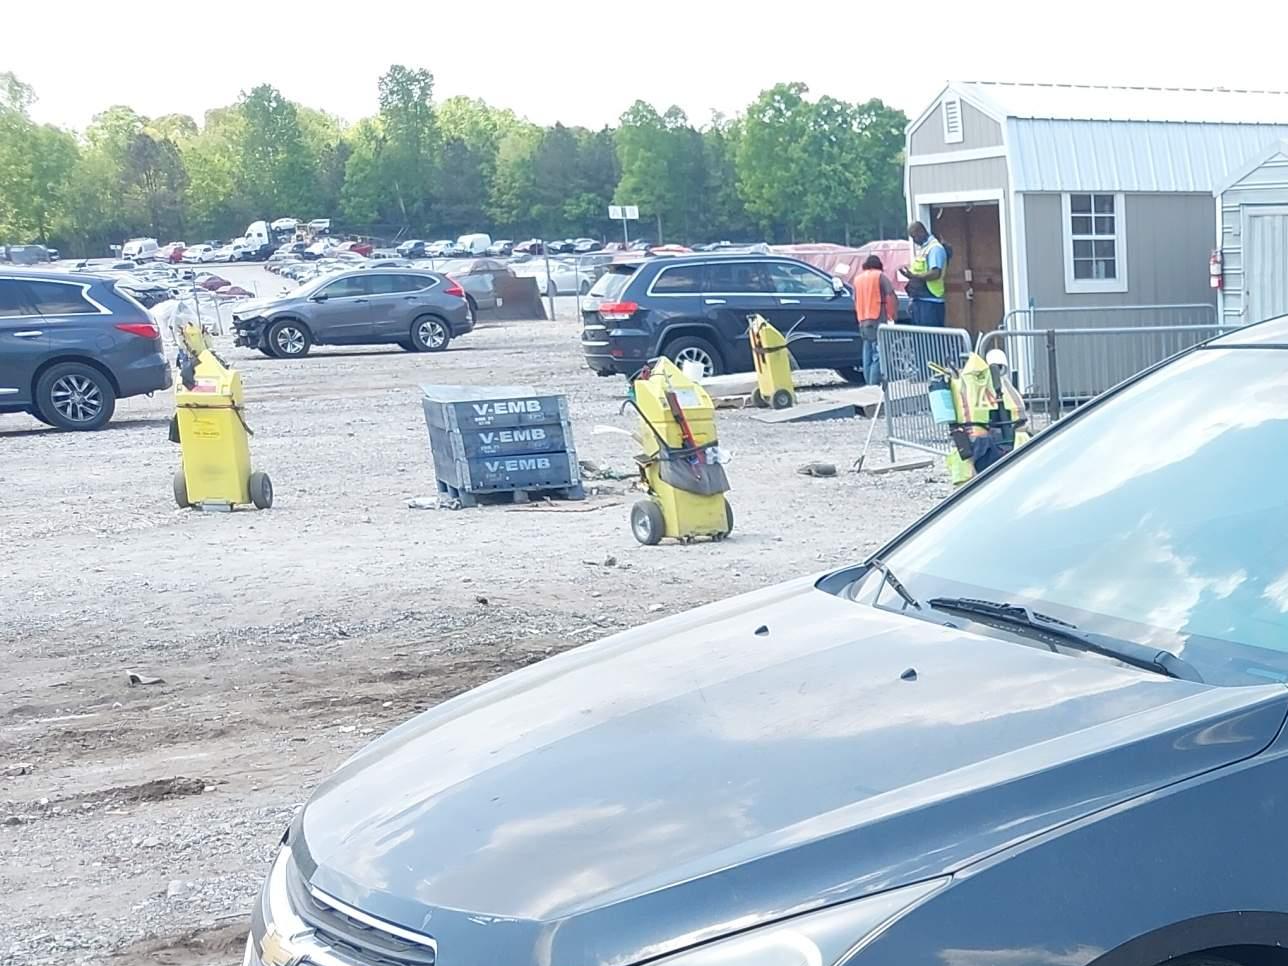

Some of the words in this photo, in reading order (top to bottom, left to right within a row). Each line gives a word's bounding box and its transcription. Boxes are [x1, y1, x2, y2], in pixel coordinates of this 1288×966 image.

[473, 400, 541, 415] V-EMB
[479, 429, 546, 444] V-EMB
[485, 458, 551, 472] V-EMB
